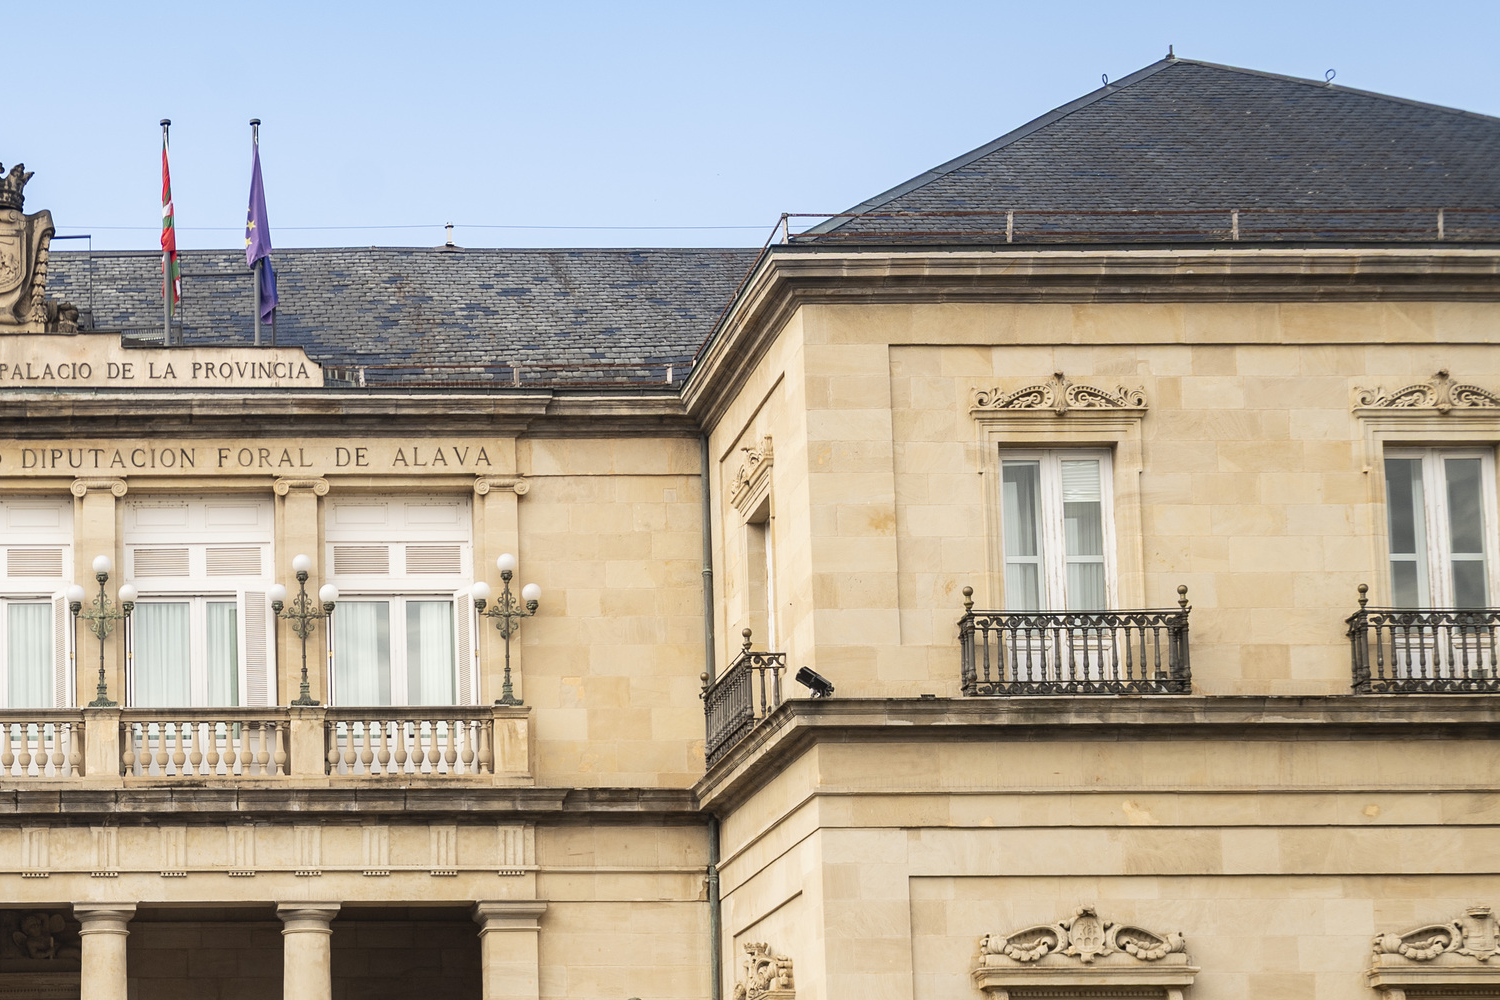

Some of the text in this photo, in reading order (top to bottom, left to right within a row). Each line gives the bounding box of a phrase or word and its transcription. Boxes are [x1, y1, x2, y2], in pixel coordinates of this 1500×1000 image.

[107, 362, 134, 380] DE
[149, 362, 176, 380] LA
[191, 362, 310, 380] PROVINCIA
[22, 448, 196, 469] DIPUTACION
[217, 447, 313, 468] FORAL
[335, 446, 369, 467] DE
[392, 446, 492, 467] ALAVA
